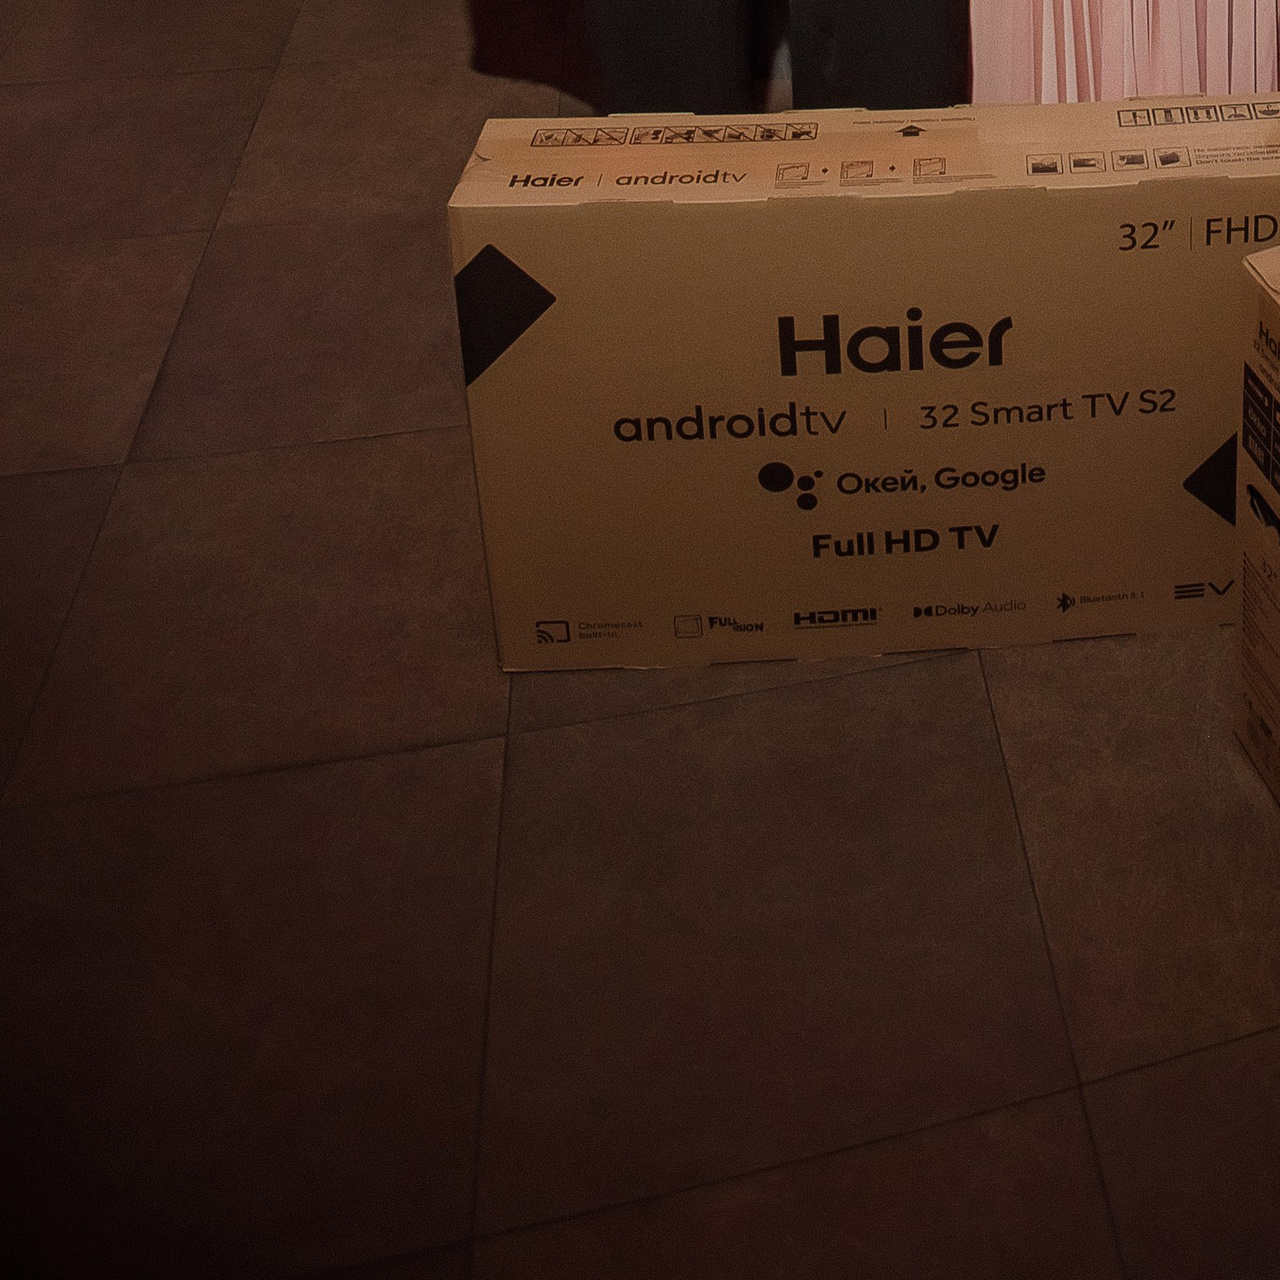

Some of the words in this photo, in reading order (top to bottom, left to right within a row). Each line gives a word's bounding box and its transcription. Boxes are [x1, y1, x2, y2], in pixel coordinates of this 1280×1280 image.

[508, 174, 584, 188] Haier
[615, 170, 747, 186] androidtv
[1206, 214, 1279, 246] FHD
[777, 307, 1014, 377] Haier
[613, 401, 847, 442] androidtv
[919, 405, 960, 430] 32
[970, 397, 1074, 427] Smart
[1081, 391, 1131, 417] TV
[1138, 388, 1178, 414] S2
[836, 470, 928, 495] Окей,
[934, 462, 1047, 493] Google
[812, 532, 875, 559] Full
[885, 529, 940, 555] HD
[949, 524, 1000, 550] TV
[793, 608, 878, 625] HDMI
[935, 603, 979, 617] Dolby
[982, 599, 1027, 614] Audio
